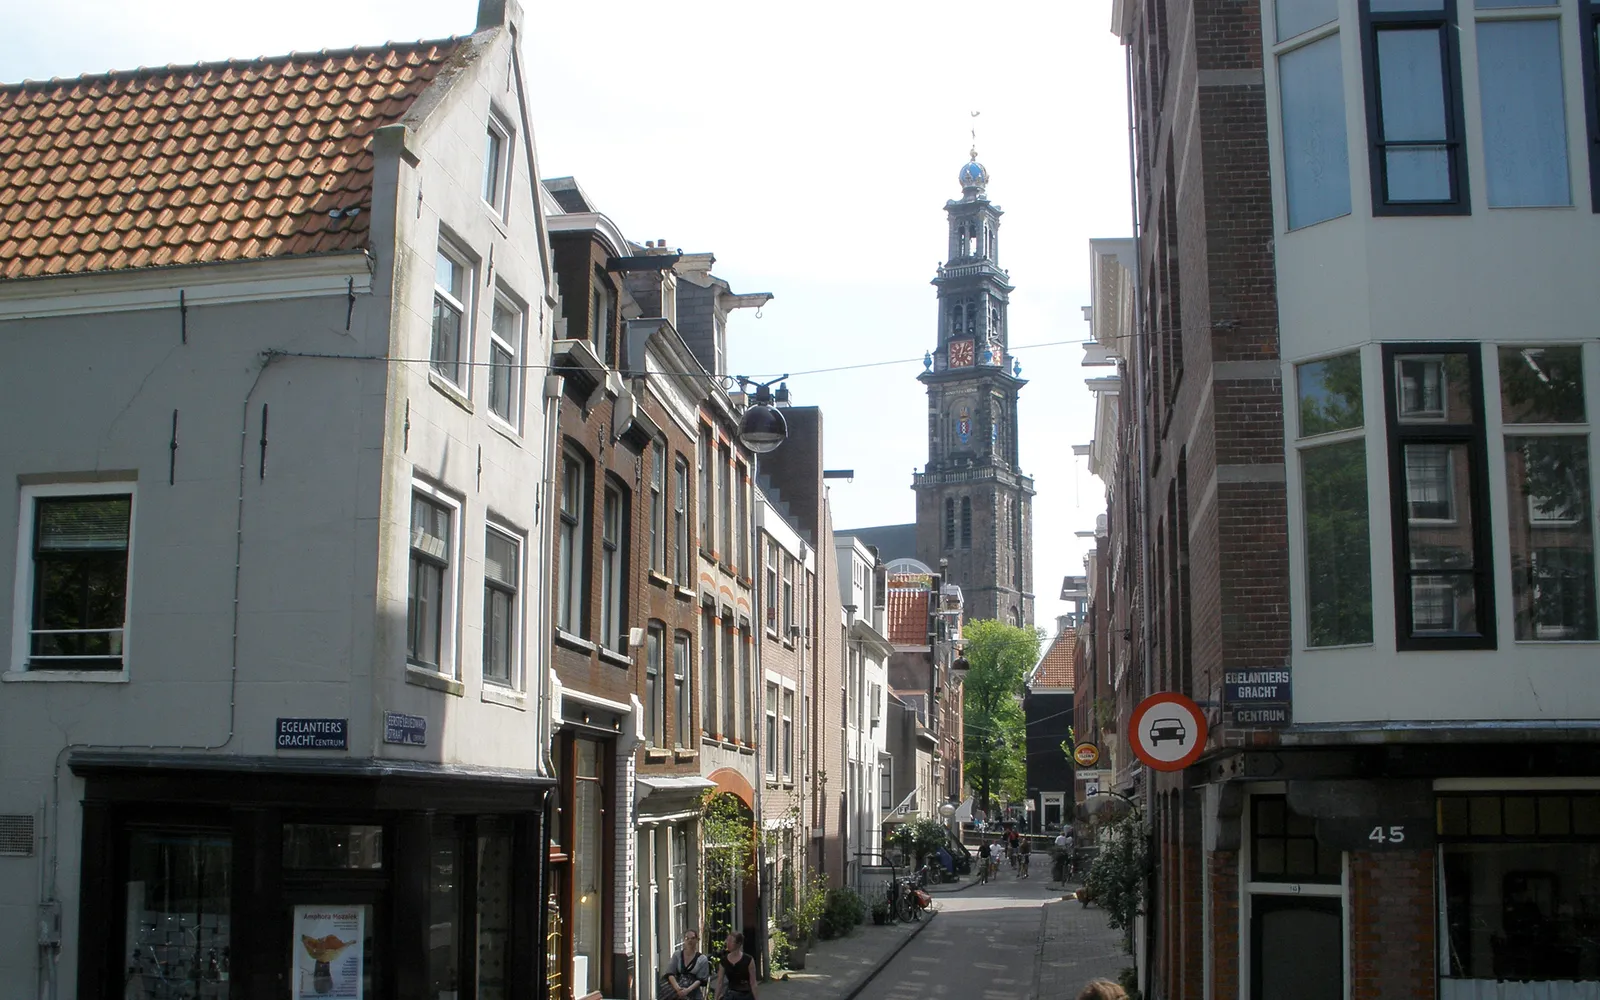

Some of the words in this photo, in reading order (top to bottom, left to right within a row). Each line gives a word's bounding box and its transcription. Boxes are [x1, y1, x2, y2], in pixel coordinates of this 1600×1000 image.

[1225, 671, 1289, 684] EGELANTIERS
[1238, 686, 1278, 698] GRACHT
[1237, 710, 1285, 722] CENTRUM
[281, 721, 342, 733] EGELANTIERS
[278, 734, 315, 747] GRACHT
[315, 739, 344, 747] CENTRUM
[1368, 826, 1405, 843] 45
[304, 913, 331, 921] Amphora
